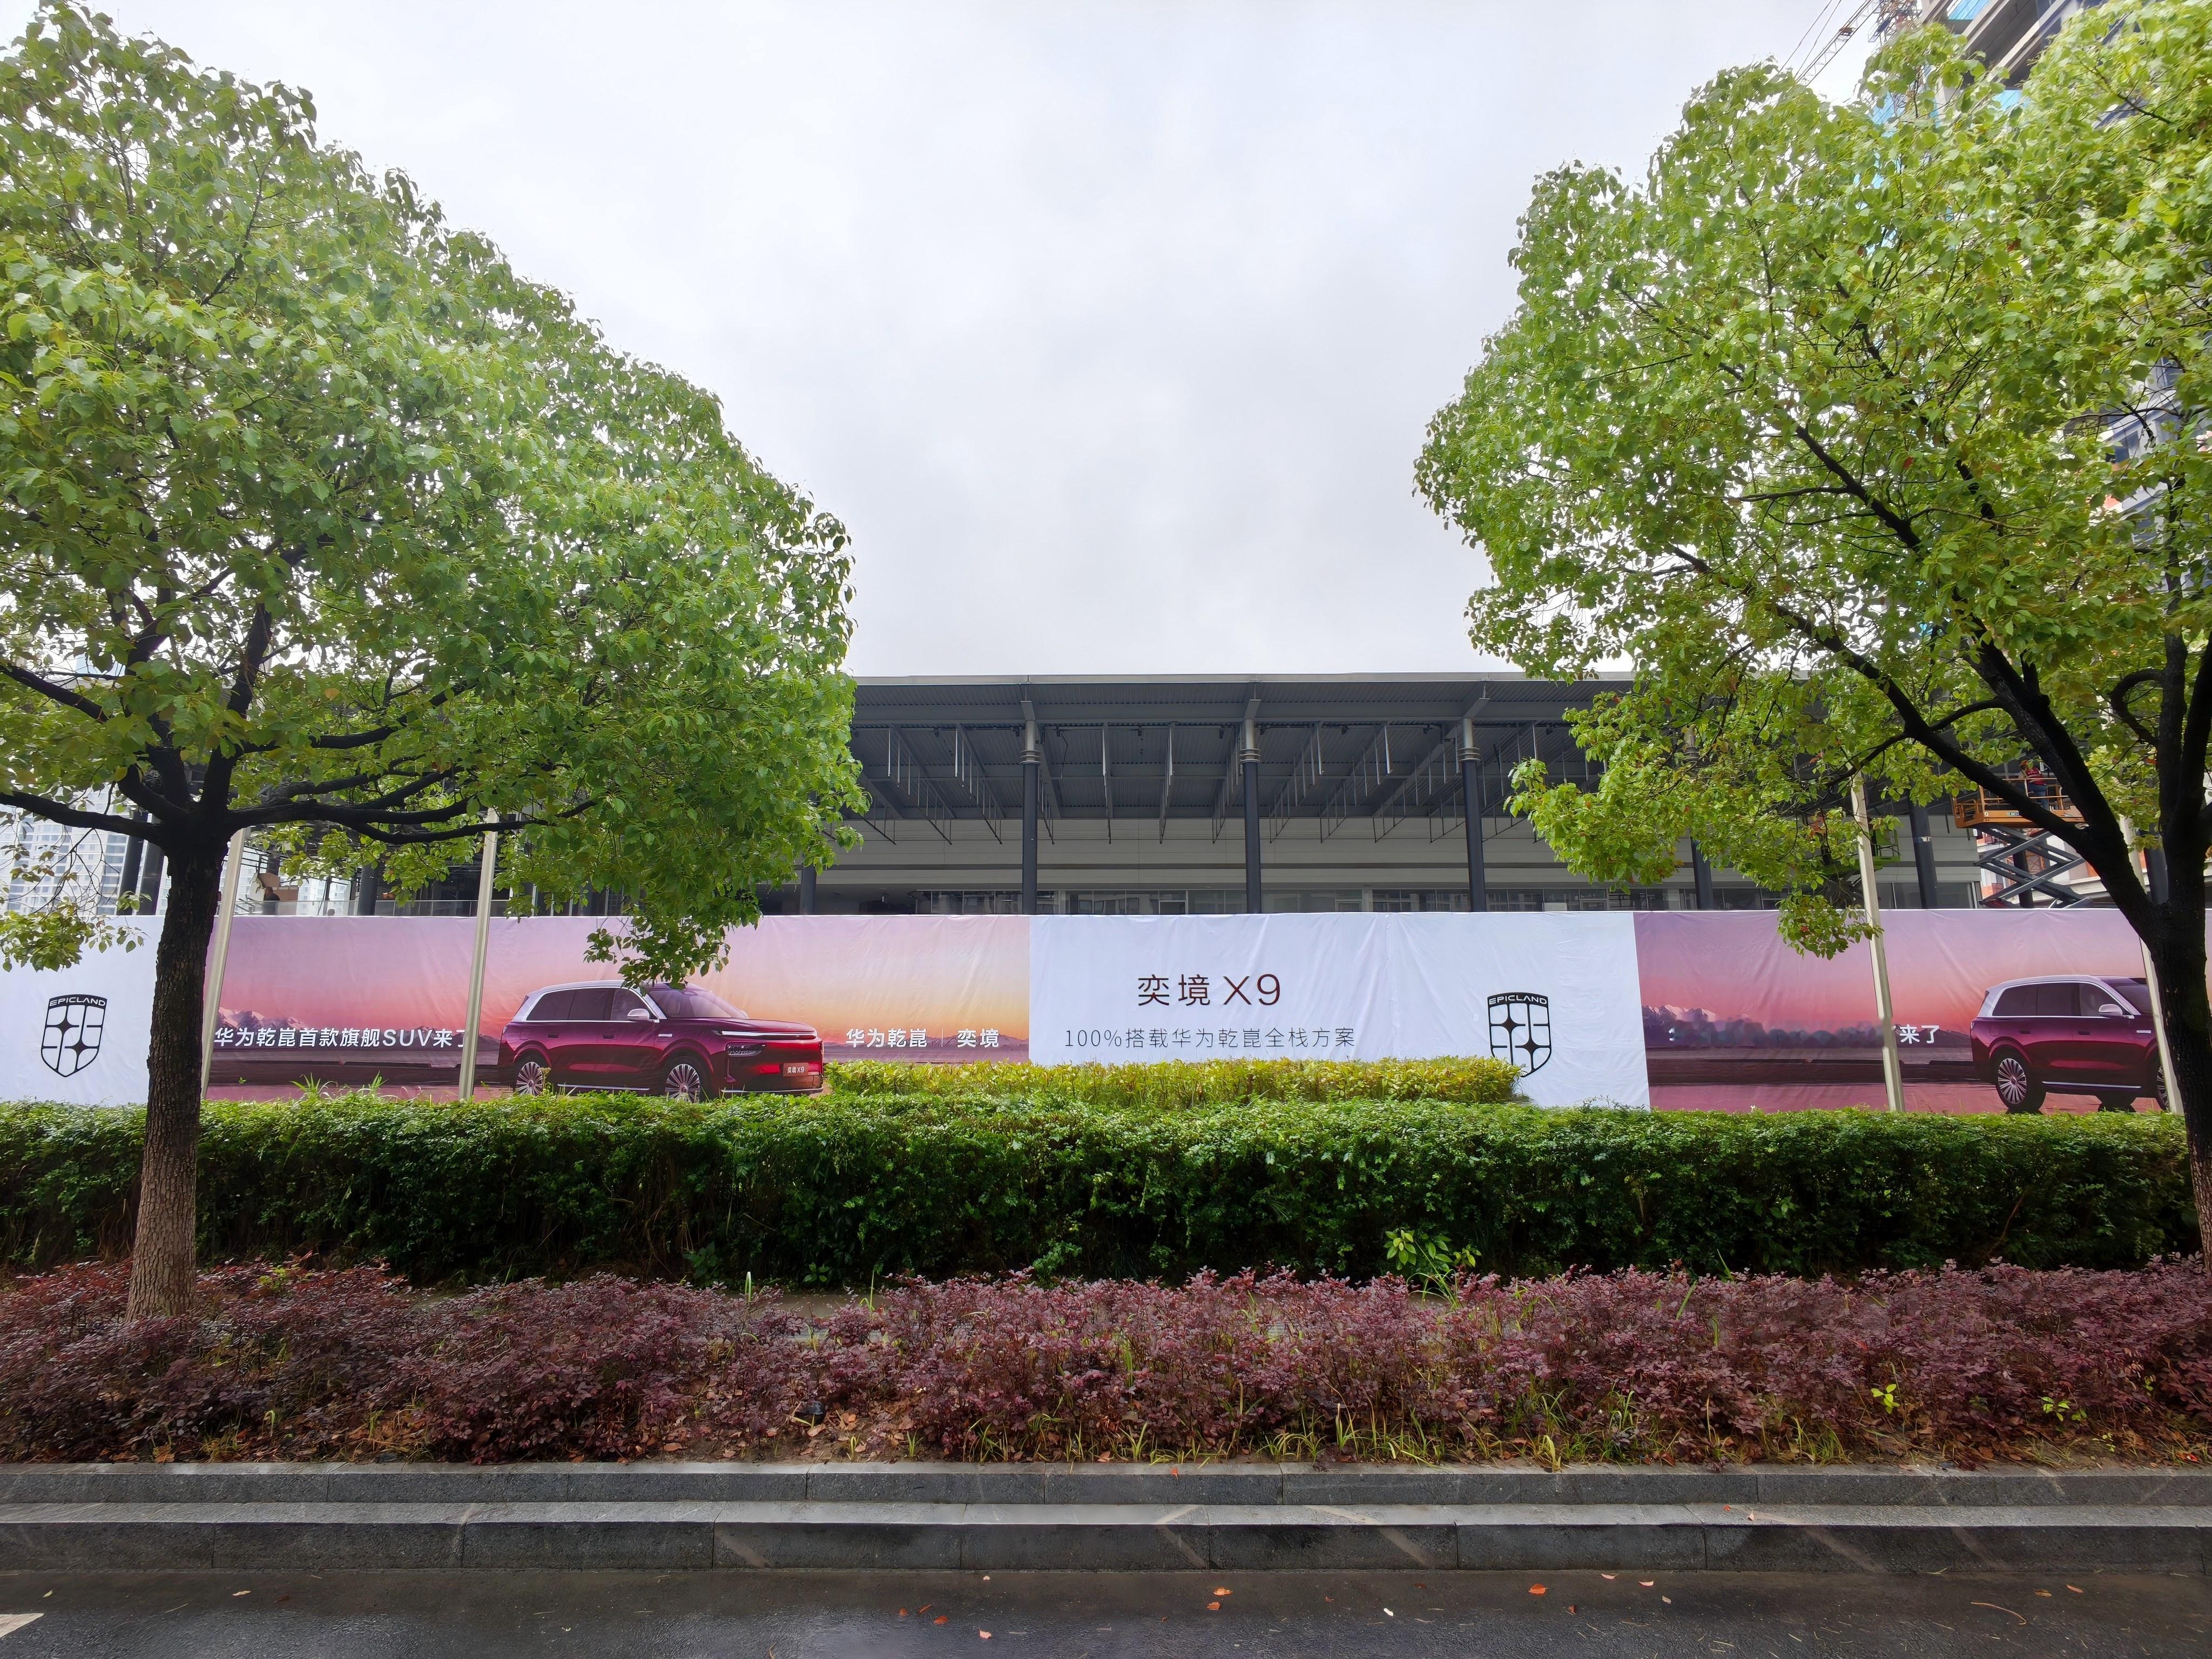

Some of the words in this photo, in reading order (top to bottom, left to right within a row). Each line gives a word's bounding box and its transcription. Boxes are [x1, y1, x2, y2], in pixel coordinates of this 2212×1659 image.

[50, 997, 106, 1006] EPICLAND
[1489, 995, 1547, 1005] EPICLAND
[846, 1028, 927, 1047] 华为乾崑
[957, 1028, 999, 1047] 奕境
[1065, 1027, 1354, 1048] 100%搭载华为乾崑全栈方案
